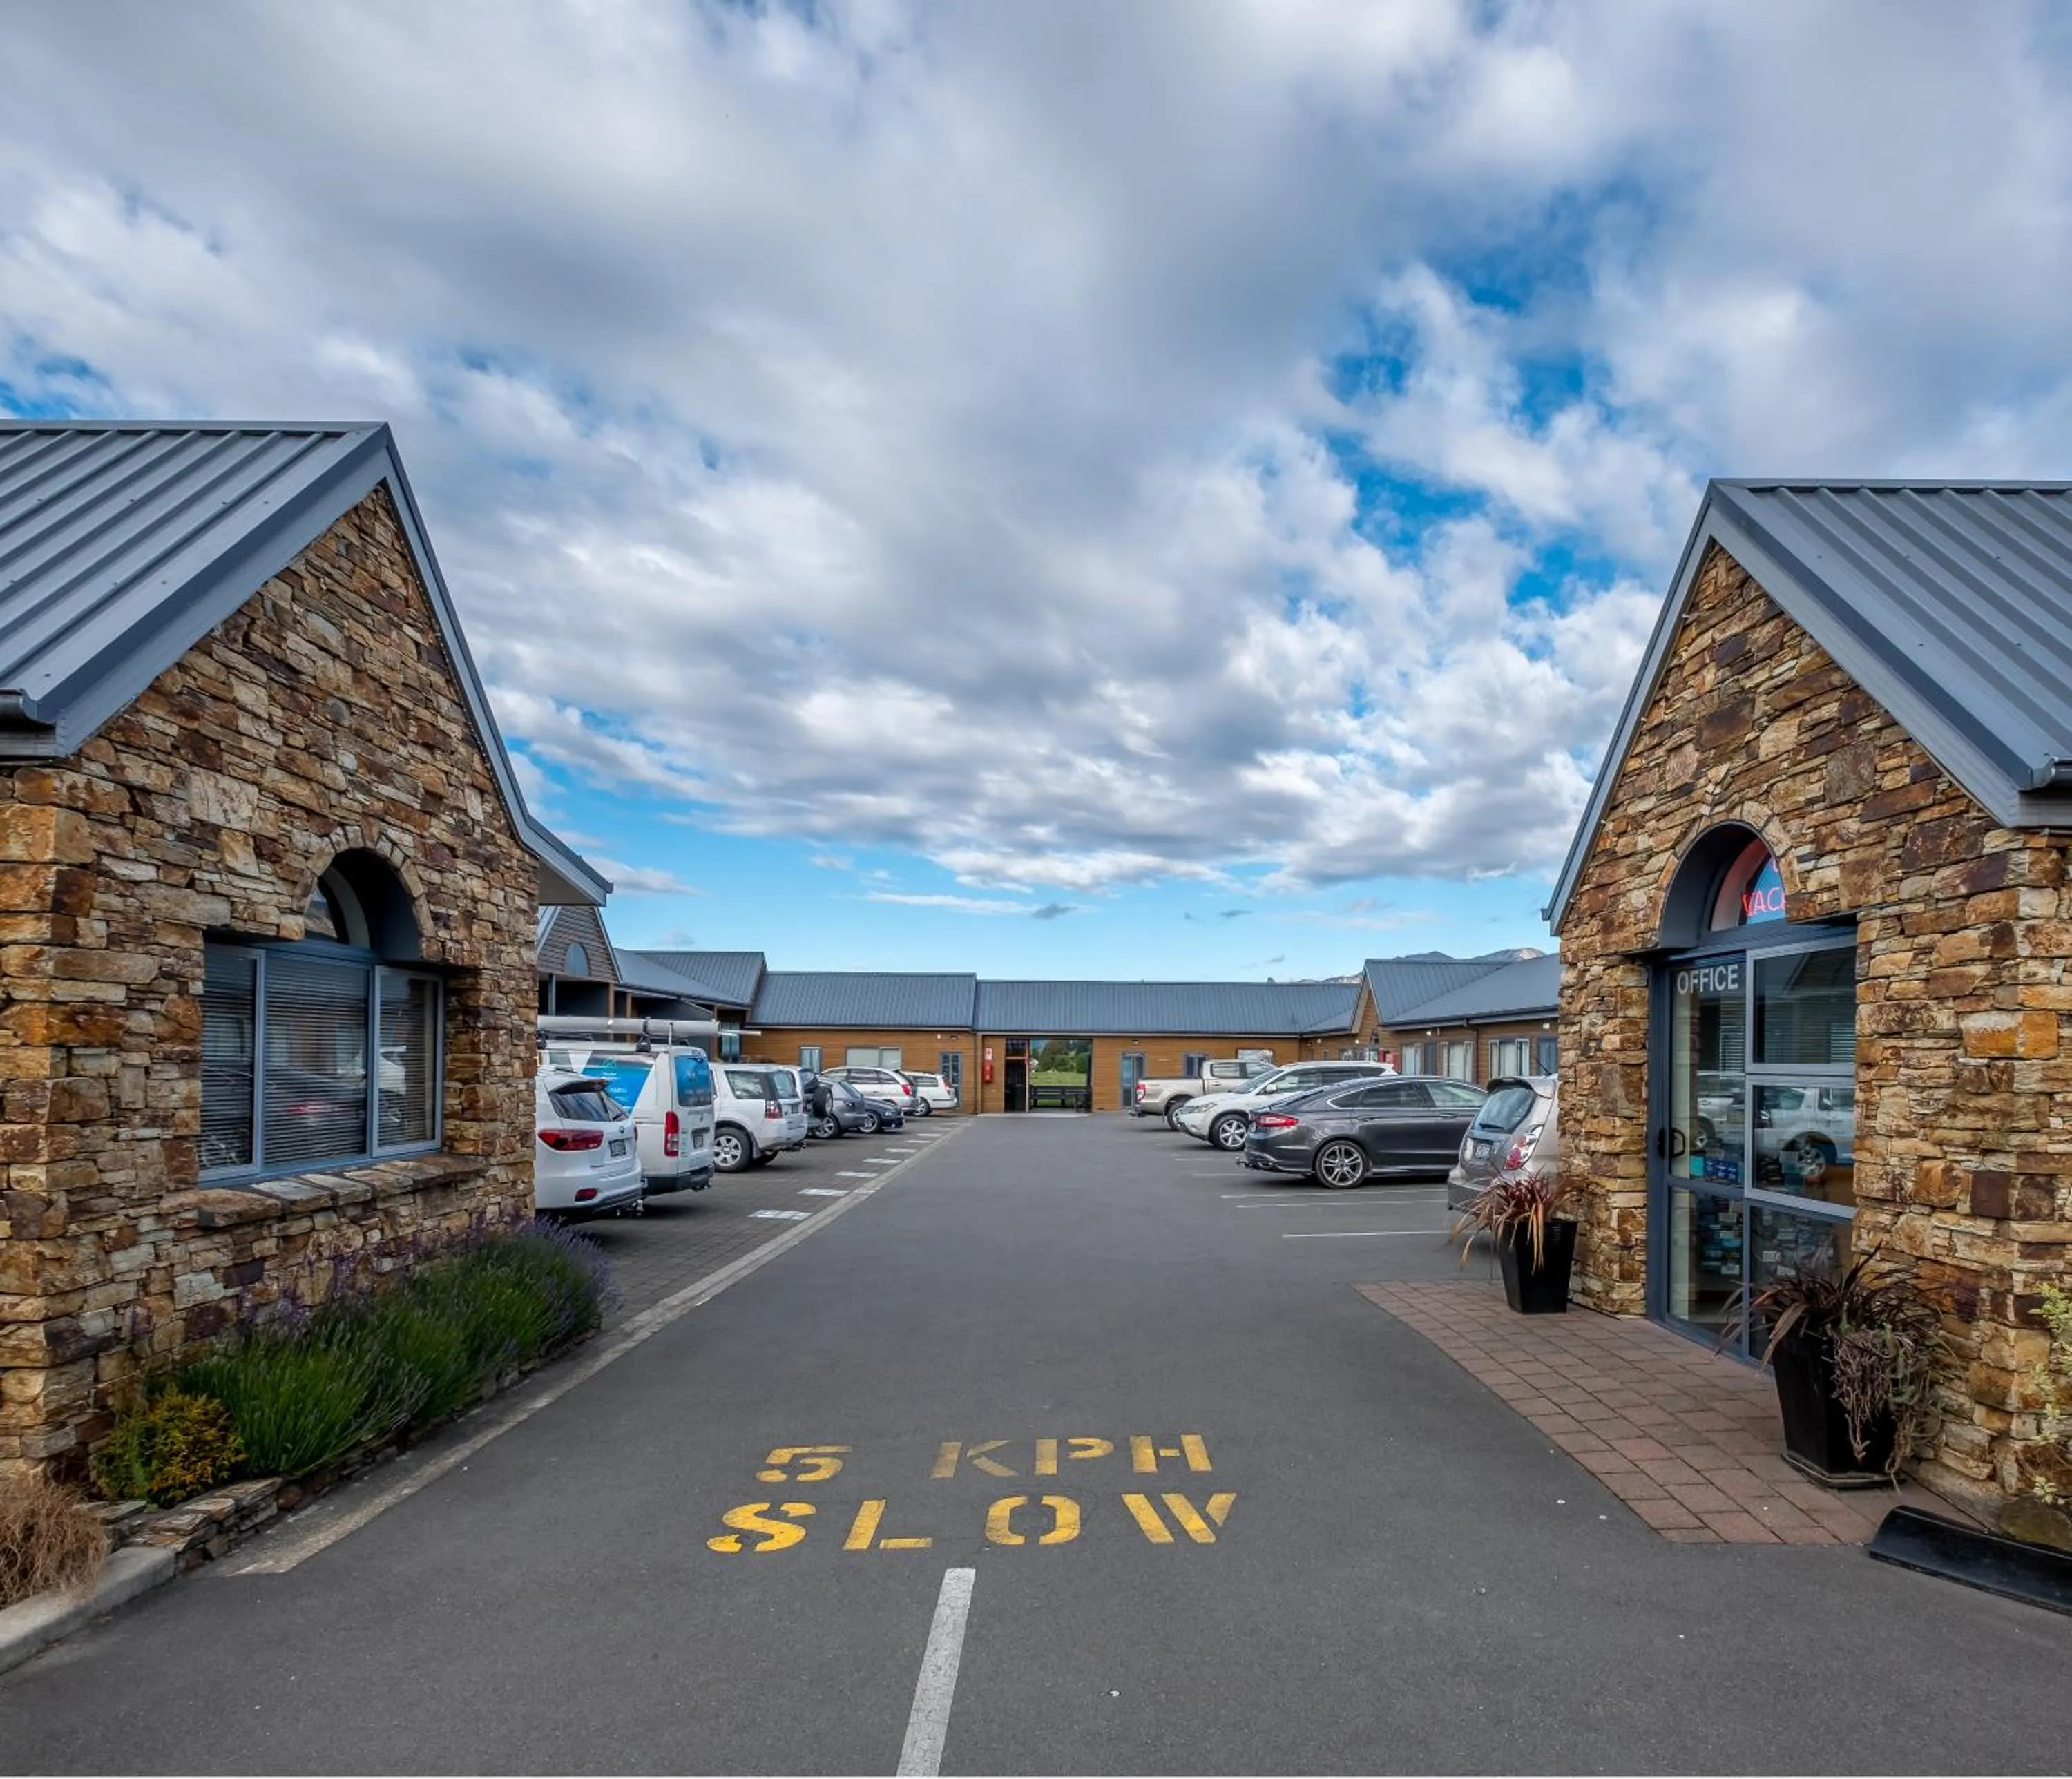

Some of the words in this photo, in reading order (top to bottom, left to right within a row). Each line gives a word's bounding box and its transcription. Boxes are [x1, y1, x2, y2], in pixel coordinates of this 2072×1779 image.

[1676, 964, 1738, 995] OFFICE
[756, 1445, 852, 1483] 5
[929, 1433, 1214, 1479] KPH
[707, 1492, 1237, 1554] SLOW
